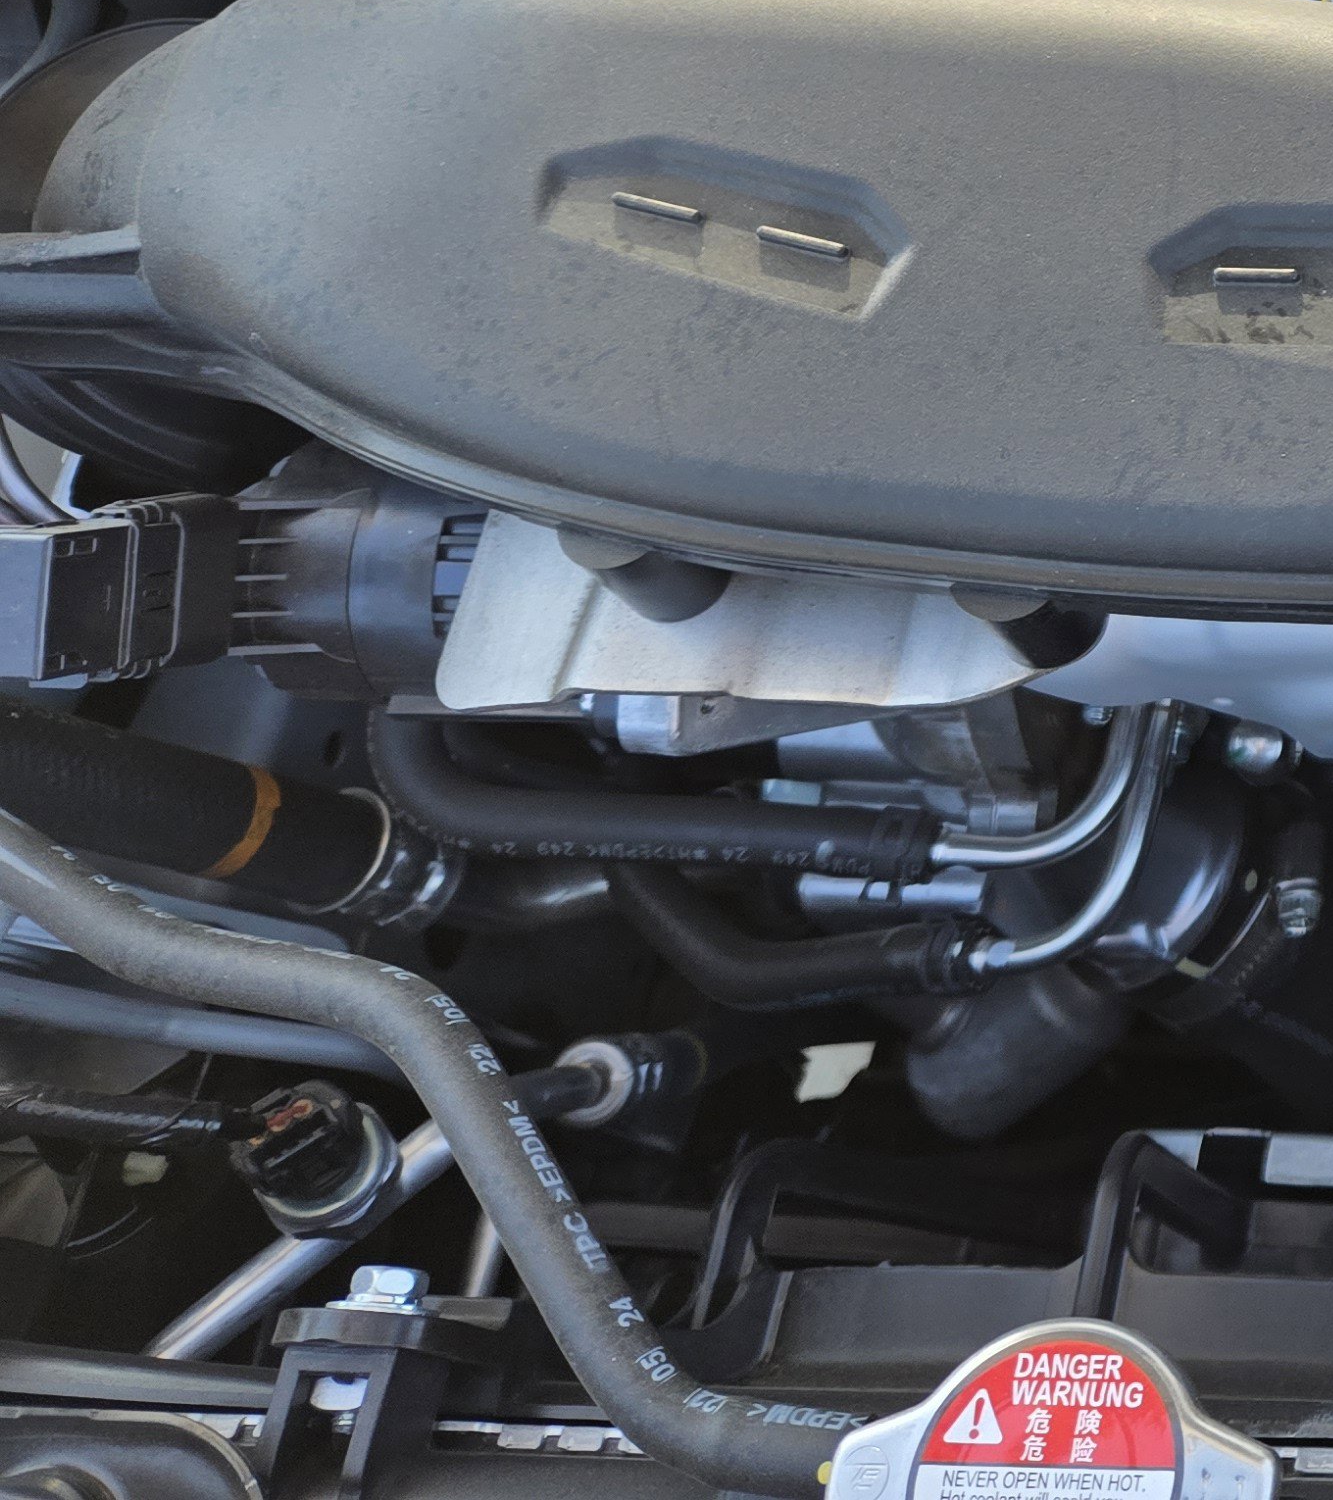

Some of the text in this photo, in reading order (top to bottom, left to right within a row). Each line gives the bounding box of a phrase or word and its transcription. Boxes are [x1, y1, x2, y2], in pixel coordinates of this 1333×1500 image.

[563, 1211, 609, 1274] TPC
[608, 1296, 645, 1328] 24
[1013, 1352, 1124, 1381] DANGER
[1011, 1380, 1145, 1409] WARNUNG
[942, 1469, 1147, 1493] NEVER OPEN WHEN HOT.
